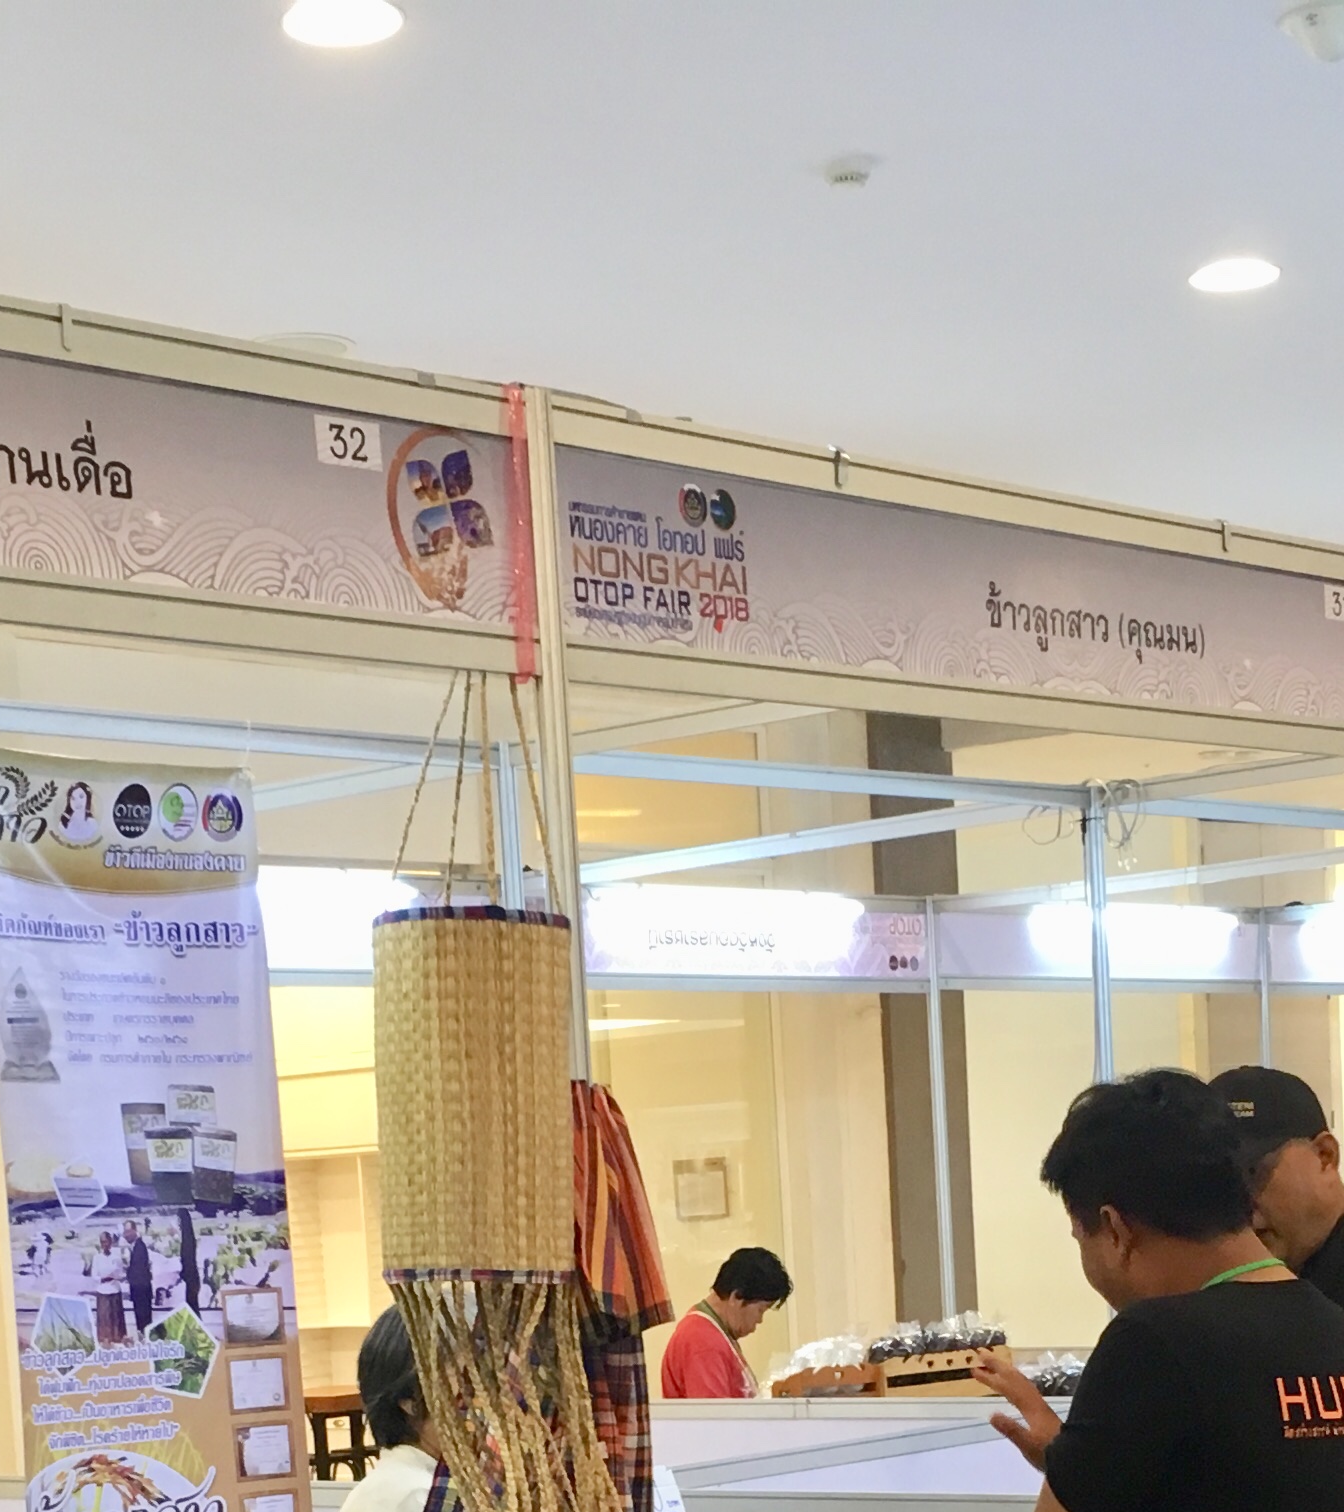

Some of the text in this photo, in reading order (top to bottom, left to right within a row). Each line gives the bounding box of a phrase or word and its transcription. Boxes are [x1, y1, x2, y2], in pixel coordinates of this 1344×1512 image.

[328, 424, 368, 462] 32
[569, 514, 745, 562] หนองคาย โอทอป แฟร์
[572, 542, 748, 596] NONG KHAI
[573, 577, 634, 608] OTOP
[643, 586, 692, 616] FAIR
[699, 592, 750, 622] 2018
[985, 581, 1206, 665] ข้าวลูกสาว (คุณมน)
[115, 804, 150, 818] OTOP
[888, 917, 922, 936] OTOP
